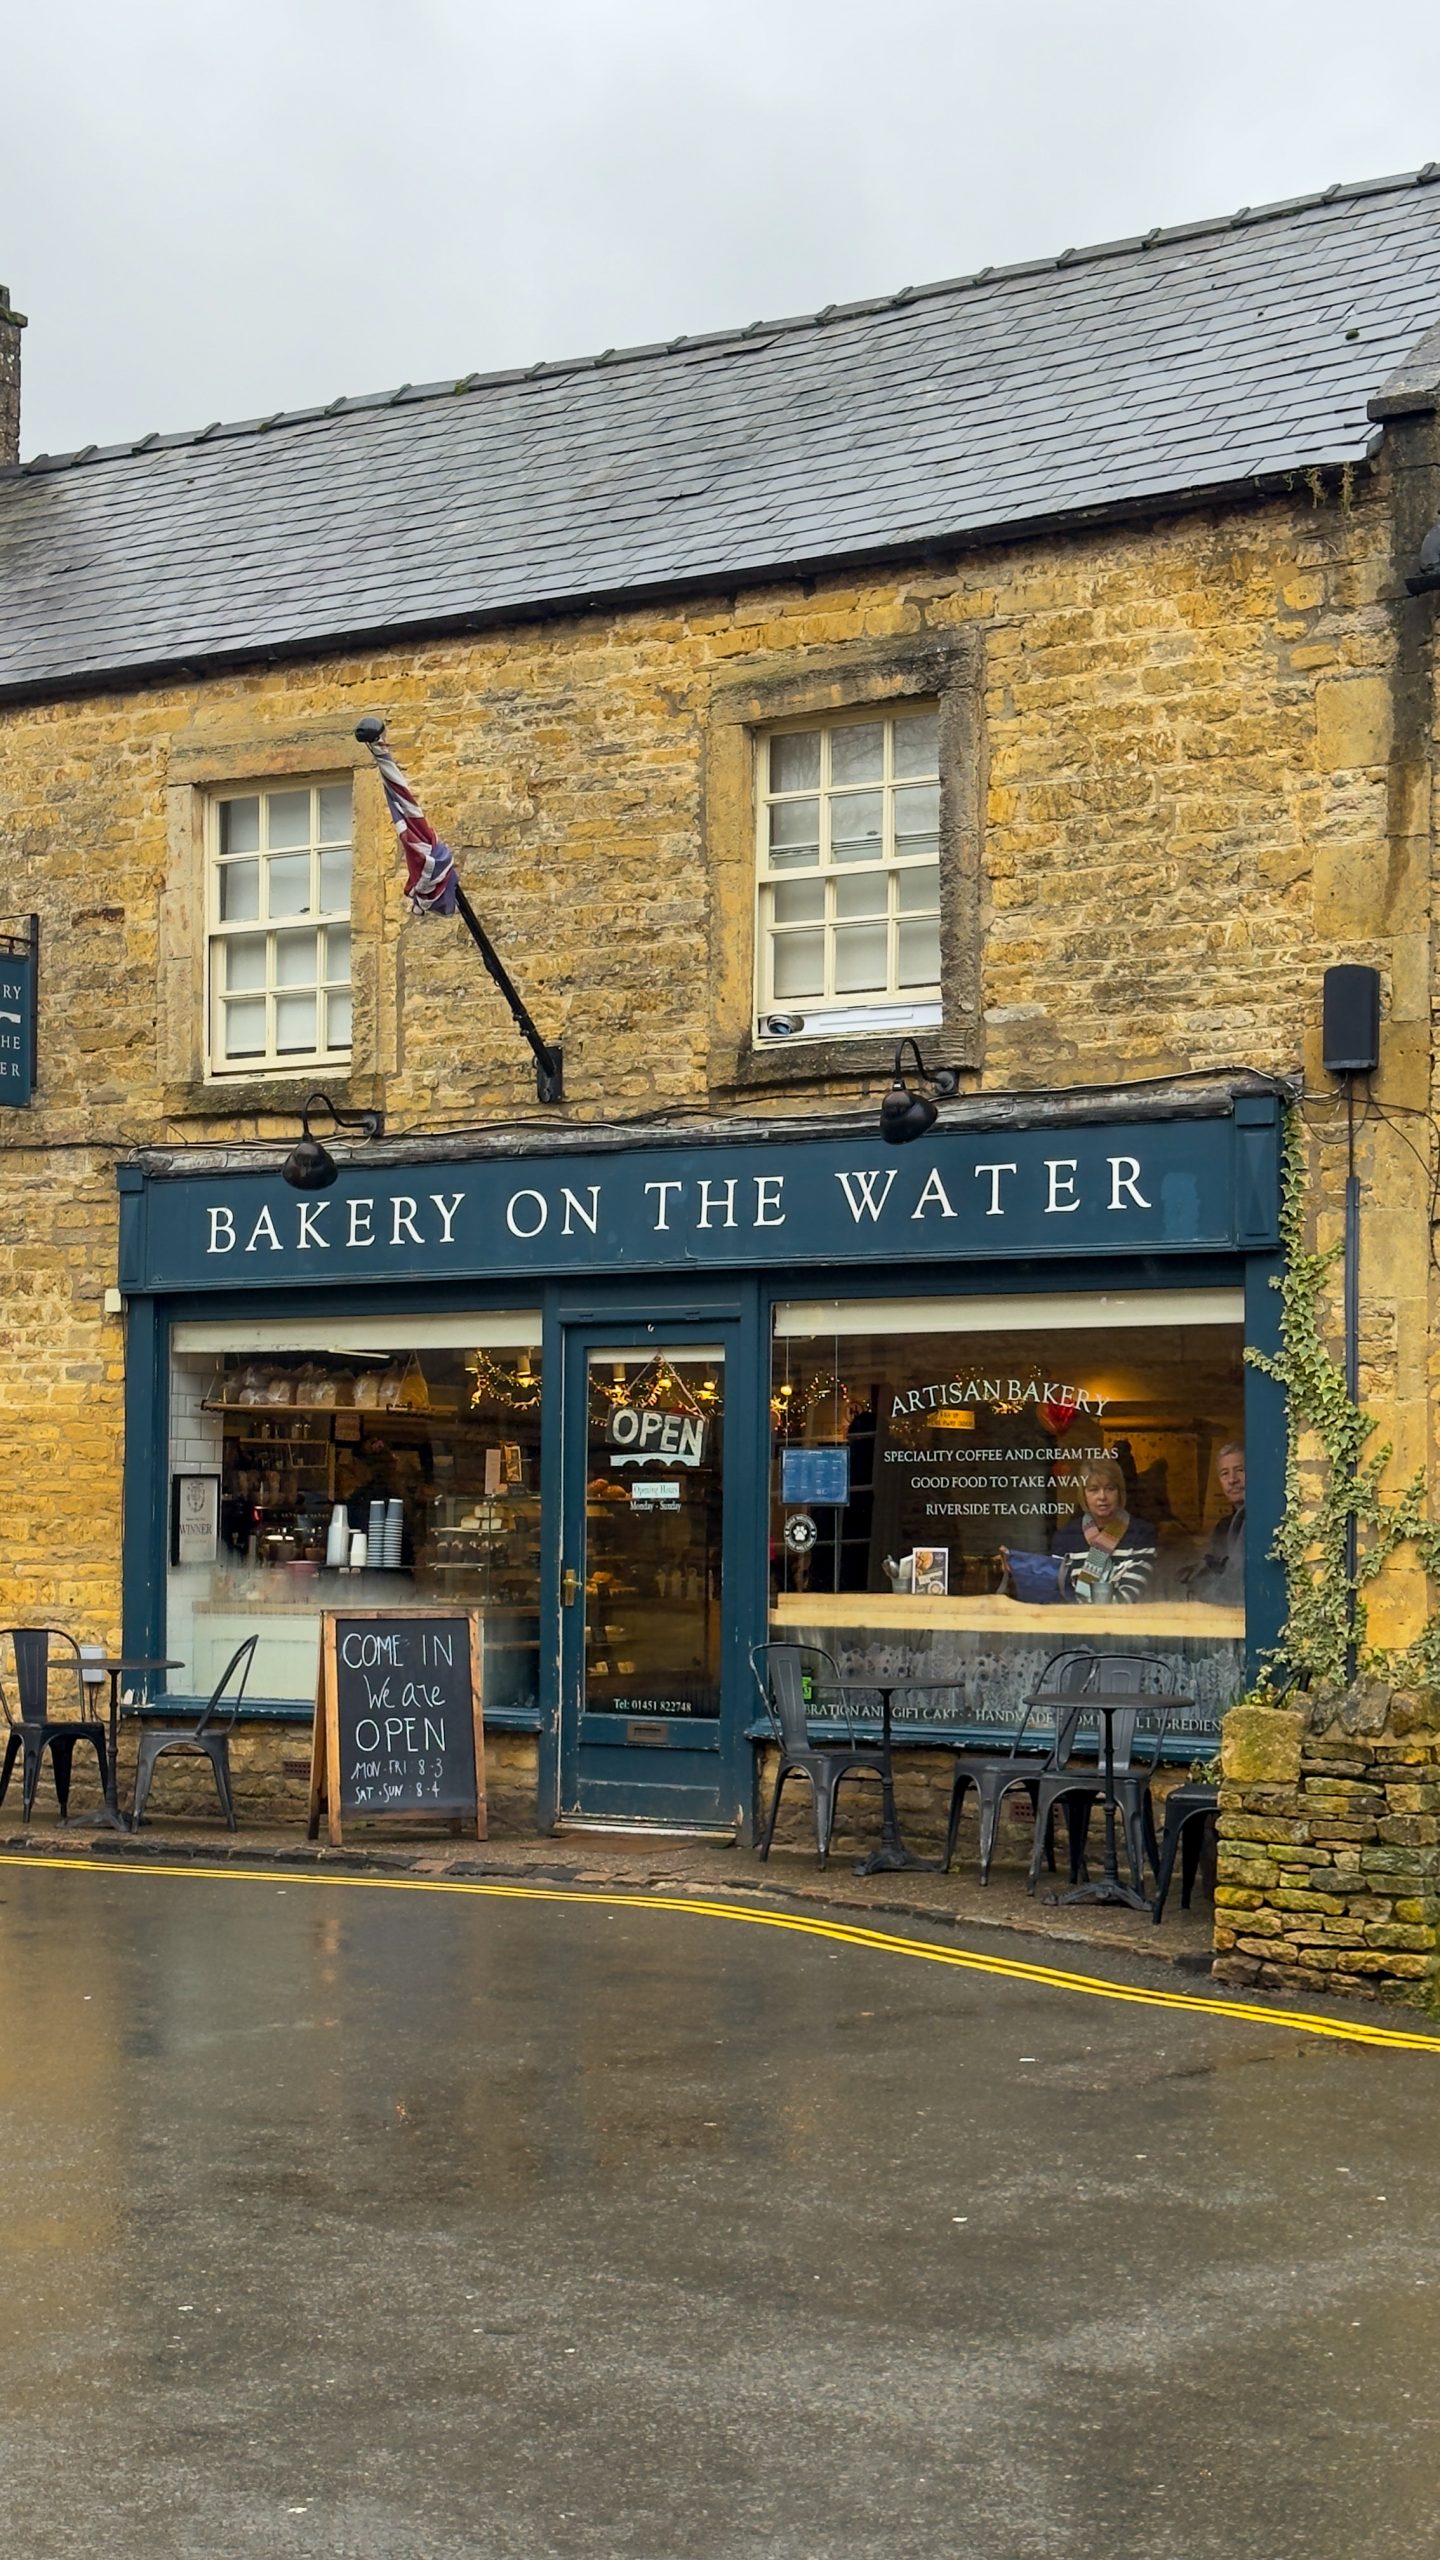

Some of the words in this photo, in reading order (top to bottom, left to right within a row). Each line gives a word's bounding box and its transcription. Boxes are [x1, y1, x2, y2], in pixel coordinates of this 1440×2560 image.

[206, 1193, 466, 1254] BAKERY
[506, 1186, 602, 1239] ON
[644, 1175, 787, 1231] THE
[834, 1156, 1152, 1224] WATER
[891, 1379, 1001, 1418] ARTISAN
[1008, 1379, 1111, 1418] BAKERY
[612, 1408, 705, 1457] OPEN
[884, 1450, 955, 1463] SPECIALITY
[955, 1449, 1003, 1462] COFFEE
[1005, 1448, 1035, 1461] AND
[1036, 1448, 1083, 1461] CREAM
[1083, 1447, 1119, 1460] TEAS
[911, 1476, 951, 1489] GOOD
[952, 1476, 988, 1489] FOOD
[989, 1476, 1009, 1489] TO
[1010, 1476, 1046, 1488] TAKE
[1047, 1475, 1090, 1488] AWAY
[630, 1500, 654, 1513] Monday
[659, 1500, 682, 1513] Sunday
[926, 1503, 990, 1516] RIVERSIDE
[992, 1503, 1018, 1516] TEA
[1019, 1502, 1075, 1515] GARDEN
[180, 1523, 212, 1536] WINNER
[342, 1633, 404, 1669] COME
[422, 1634, 453, 1668] IN
[363, 1674, 395, 1710] We
[402, 1682, 446, 1709] are
[613, 1698, 630, 1710] Tel:
[631, 1700, 657, 1711] 01451
[660, 1701, 692, 1713] 822748
[975, 1709, 1054, 1724] HANDMADE
[356, 1717, 446, 1752] OPEN
